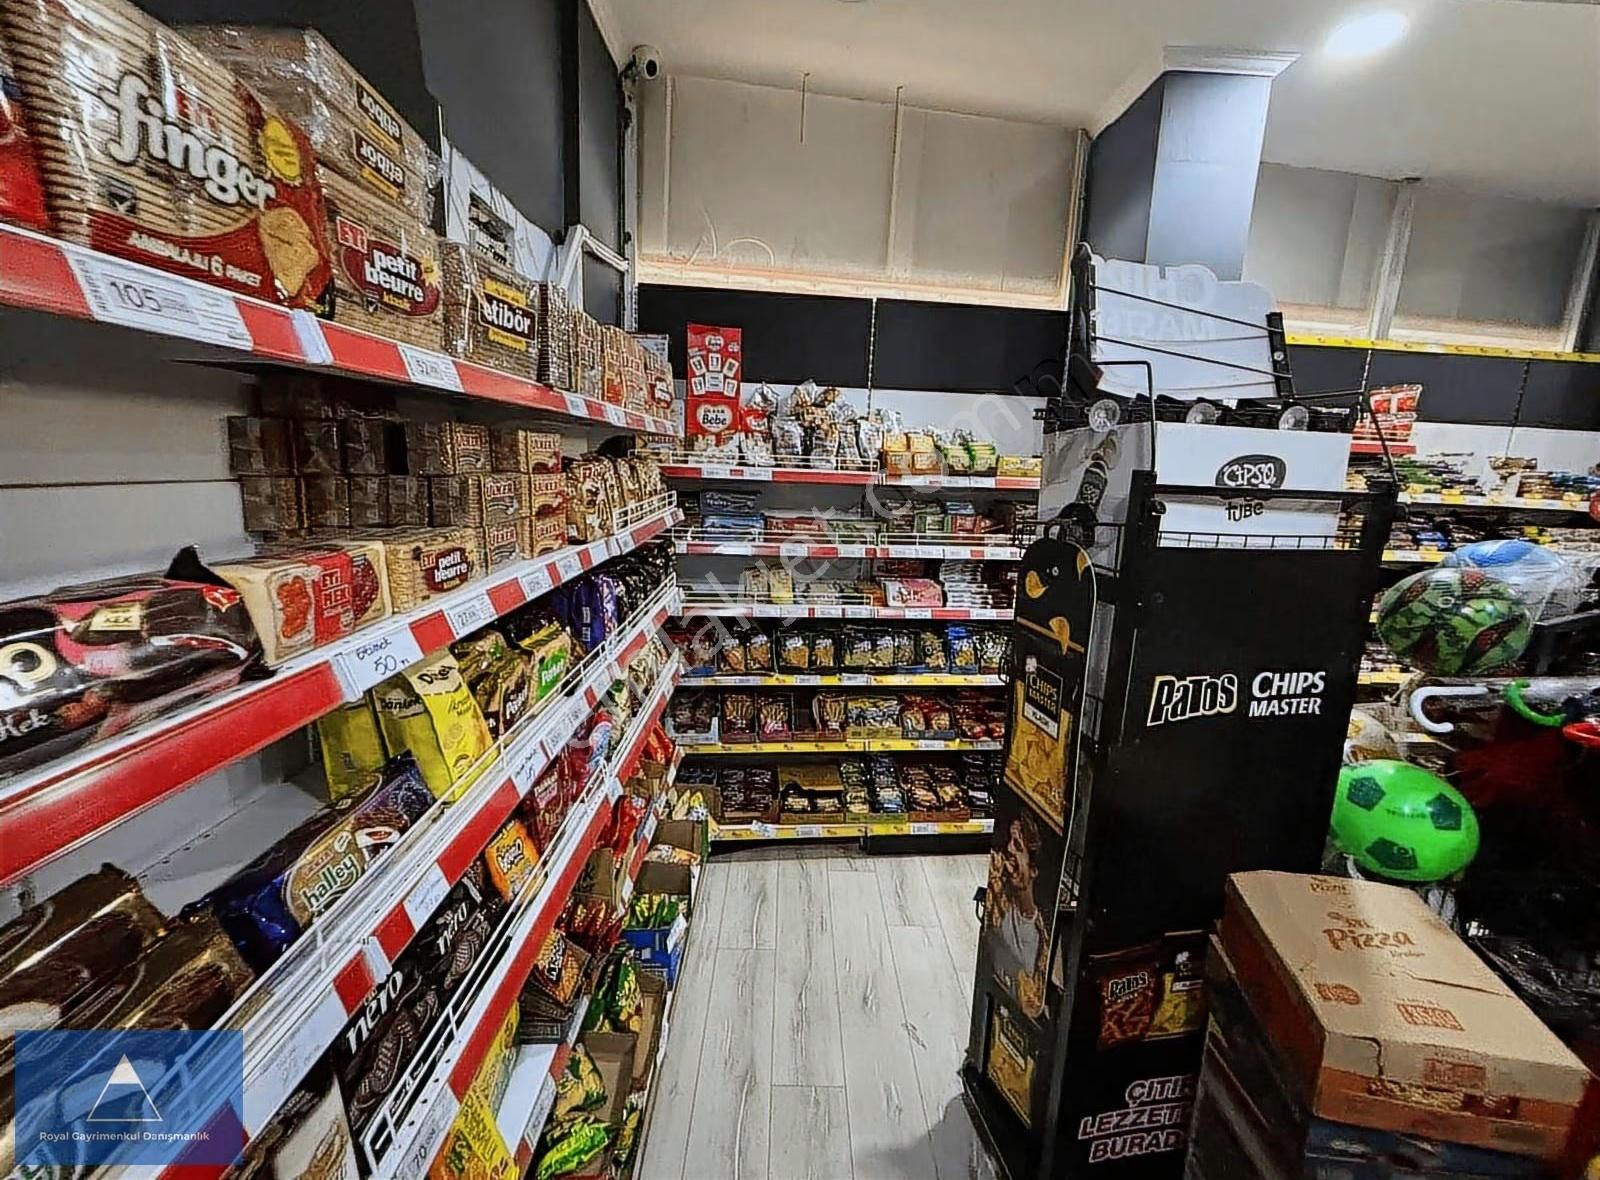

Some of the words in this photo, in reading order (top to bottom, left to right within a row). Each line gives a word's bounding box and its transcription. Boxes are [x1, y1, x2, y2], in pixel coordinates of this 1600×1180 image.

[106, 72, 276, 210] finger
[372, 249, 418, 281] petit
[364, 260, 425, 303] beurre
[484, 299, 531, 334] etibör
[701, 413, 728, 426] Bebe
[434, 563, 468, 583] beurre
[438, 551, 461, 570] petit
[374, 654, 398, 676] 50
[1029, 674, 1057, 701] CHIPS
[1251, 671, 1326, 699] CHIPS
[1248, 698, 1321, 718] MASTER
[301, 853, 357, 911] halley
[436, 901, 469, 955] nero
[1322, 928, 1416, 951] Pizza
[345, 970, 404, 1054] nero
[1088, 1128, 1186, 1163] BURAD
